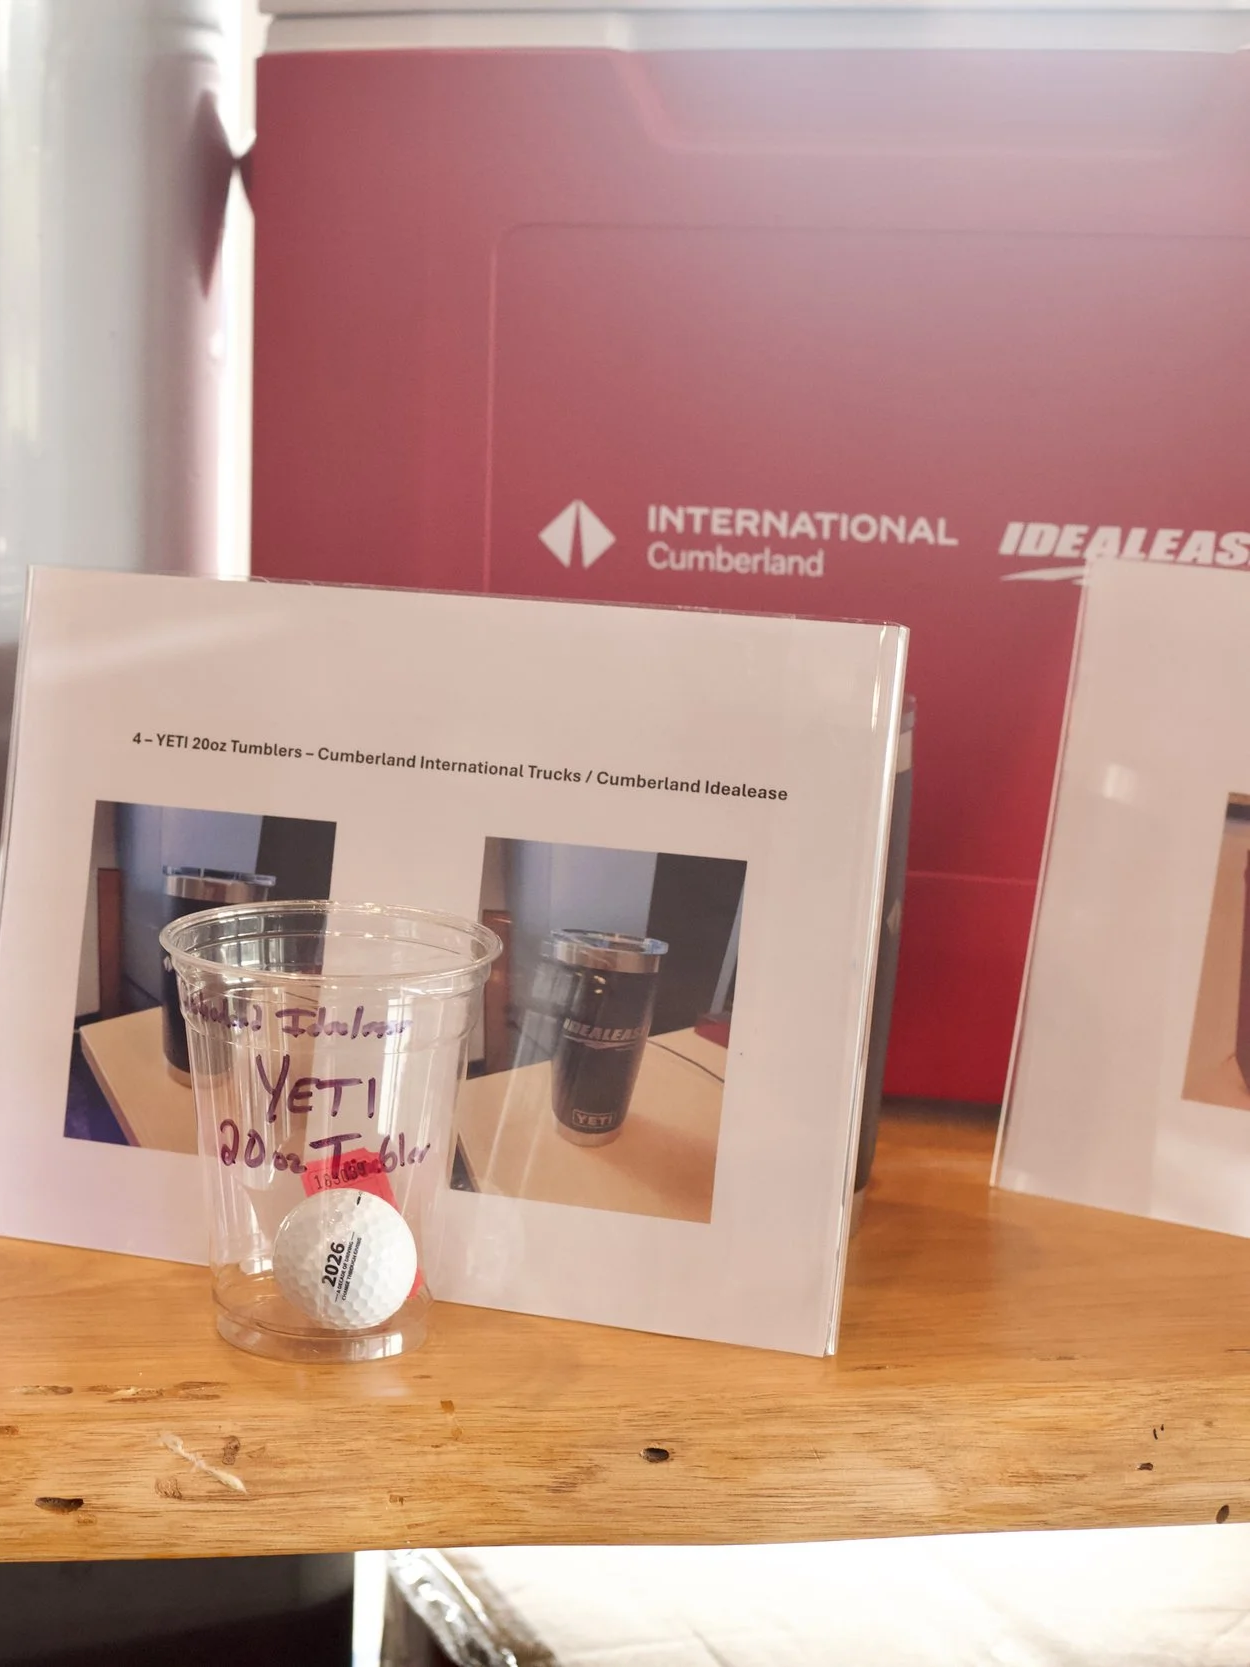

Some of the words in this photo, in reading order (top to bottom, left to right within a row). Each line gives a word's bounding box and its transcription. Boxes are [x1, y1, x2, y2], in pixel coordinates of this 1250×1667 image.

[648, 504, 959, 547] INTERNATIONAL
[998, 521, 1250, 567] IDEALEAS
[647, 540, 825, 577] Cumberland
[132, 732, 142, 745] 4
[157, 733, 188, 748] YETI
[192, 737, 227, 752] 20oz
[231, 740, 303, 758] Tumblers
[318, 747, 417, 768] Cumberland
[421, 756, 525, 778] International
[528, 765, 582, 782] Trucks
[597, 771, 701, 793] Cumberland
[704, 780, 788, 801] Idealease
[255, 1054, 376, 1123] YETI
[576, 1111, 611, 1126] YETI
[322, 1242, 344, 1287] 2026
[337, 1271, 346, 1289] DECADE
[342, 1281, 350, 1301] CHANGE
[347, 1255, 357, 1280] THROUGH
